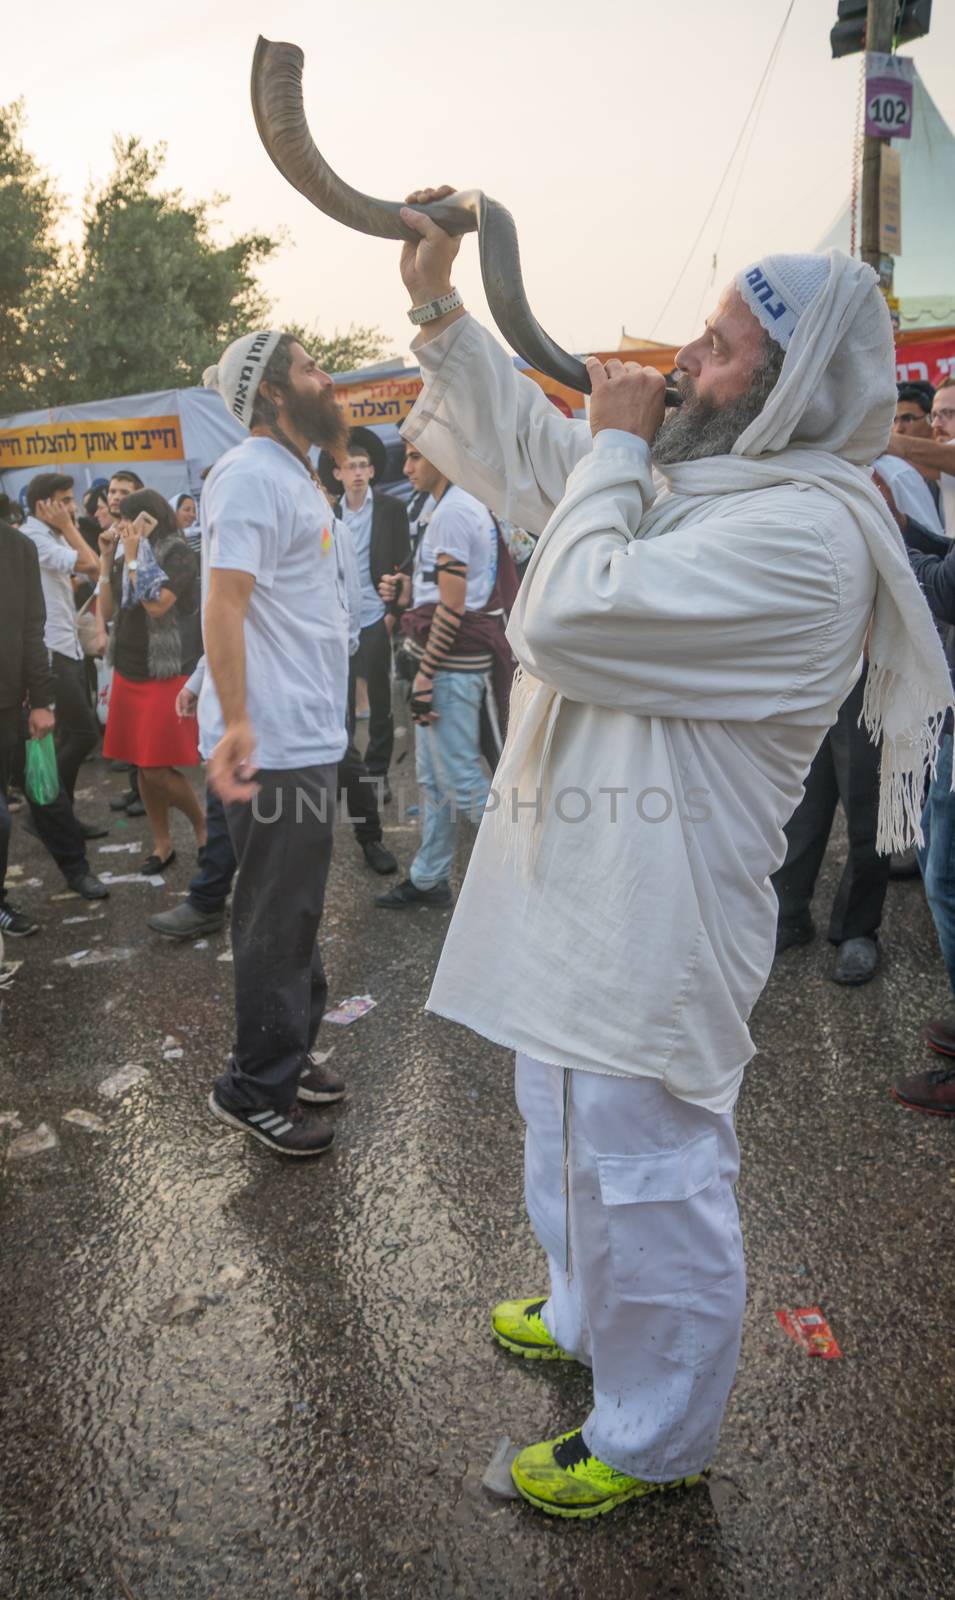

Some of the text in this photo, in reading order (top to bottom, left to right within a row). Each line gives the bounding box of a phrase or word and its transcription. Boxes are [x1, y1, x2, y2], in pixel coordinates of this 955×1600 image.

[871, 98, 907, 124] 102
[0, 427, 177, 459] חייבים אותך להצלת חיי
